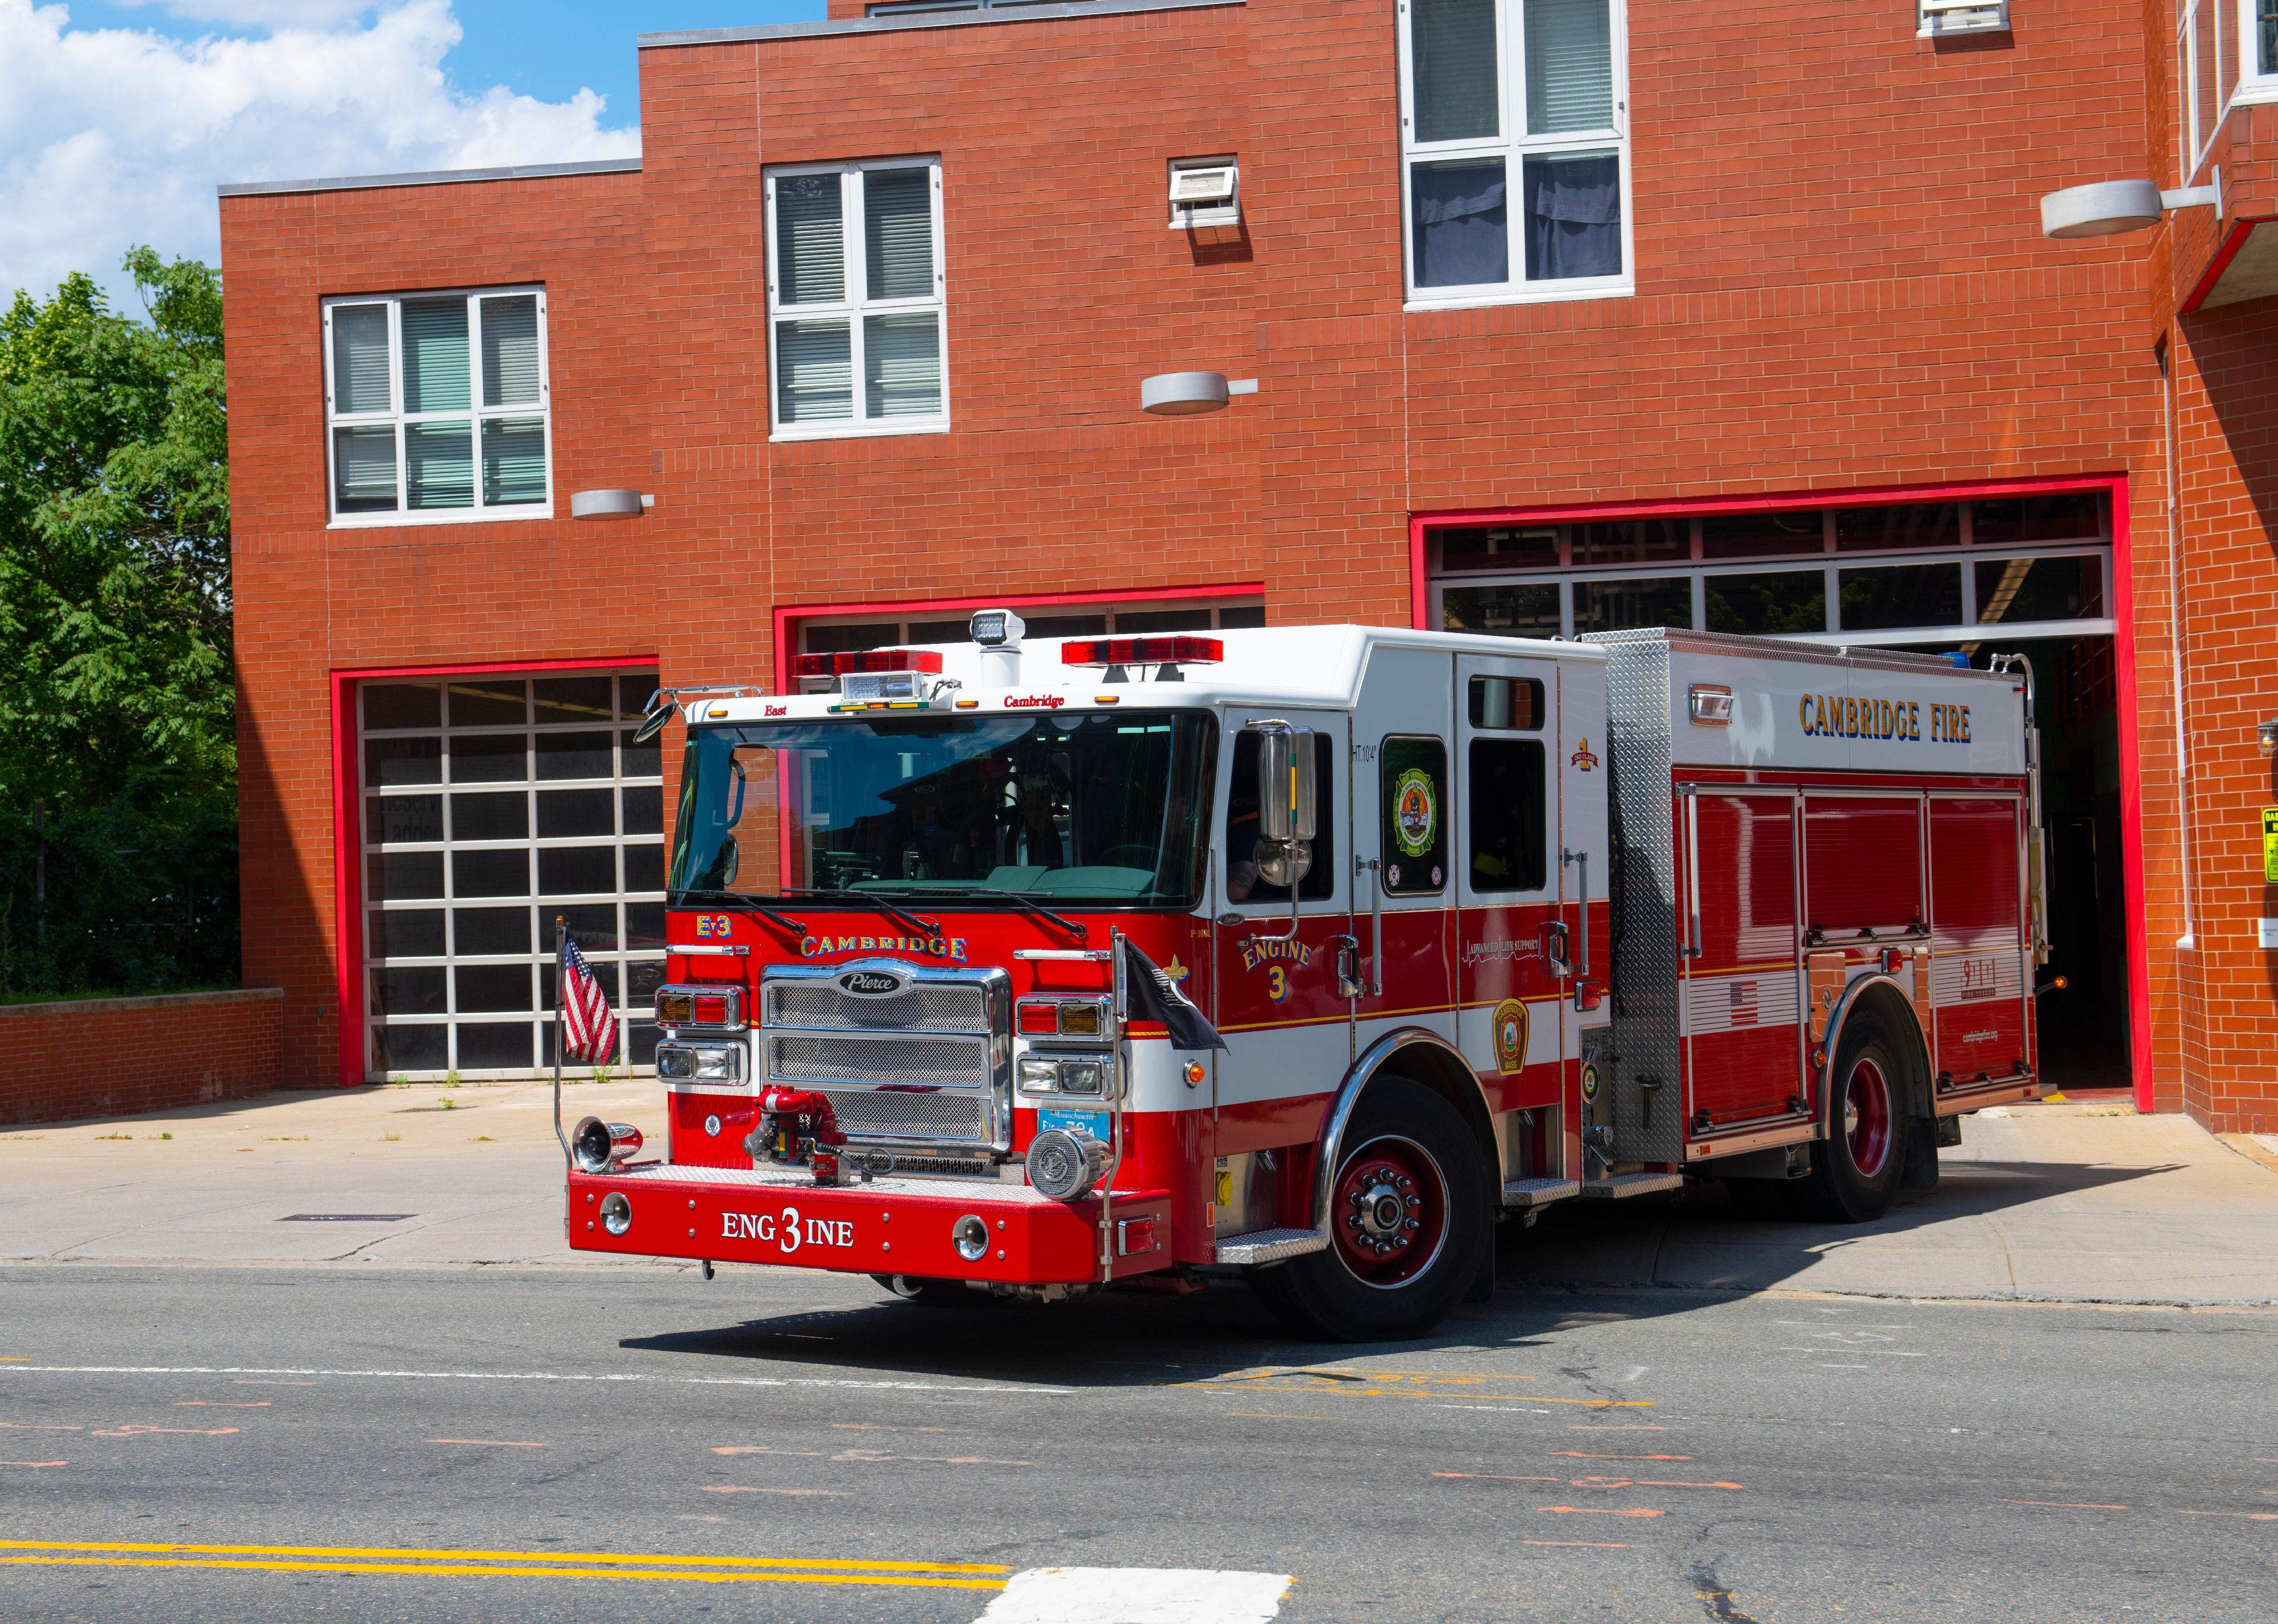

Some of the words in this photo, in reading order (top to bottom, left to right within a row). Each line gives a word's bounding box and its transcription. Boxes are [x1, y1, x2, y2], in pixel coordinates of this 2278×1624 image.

[764, 705, 787, 716] East
[1004, 694, 1065, 708] Cambridge
[1799, 693, 1920, 741] CAMBRIDGE
[1930, 703, 1971, 744] FIRE
[800, 936, 967, 963] CAMBRIDGE
[1243, 940, 1312, 972] ENGINE
[1470, 942, 1498, 954] ADVANCED
[1501, 941, 1514, 952] LIFE
[1514, 939, 1538, 951] SUPPORT
[847, 972, 893, 990] Pierce
[1269, 966, 1287, 1003] 3
[1498, 1005, 1523, 1021] CAMBRIDGE
[1963, 1029, 1998, 1043] cambridgefire.org
[1505, 1060, 1517, 1070] MASS
[1054, 1111, 1094, 1120] Massachusetts
[721, 1212, 776, 1241] ENG
[780, 1206, 801, 1253] 3
[805, 1218, 854, 1247] INE
